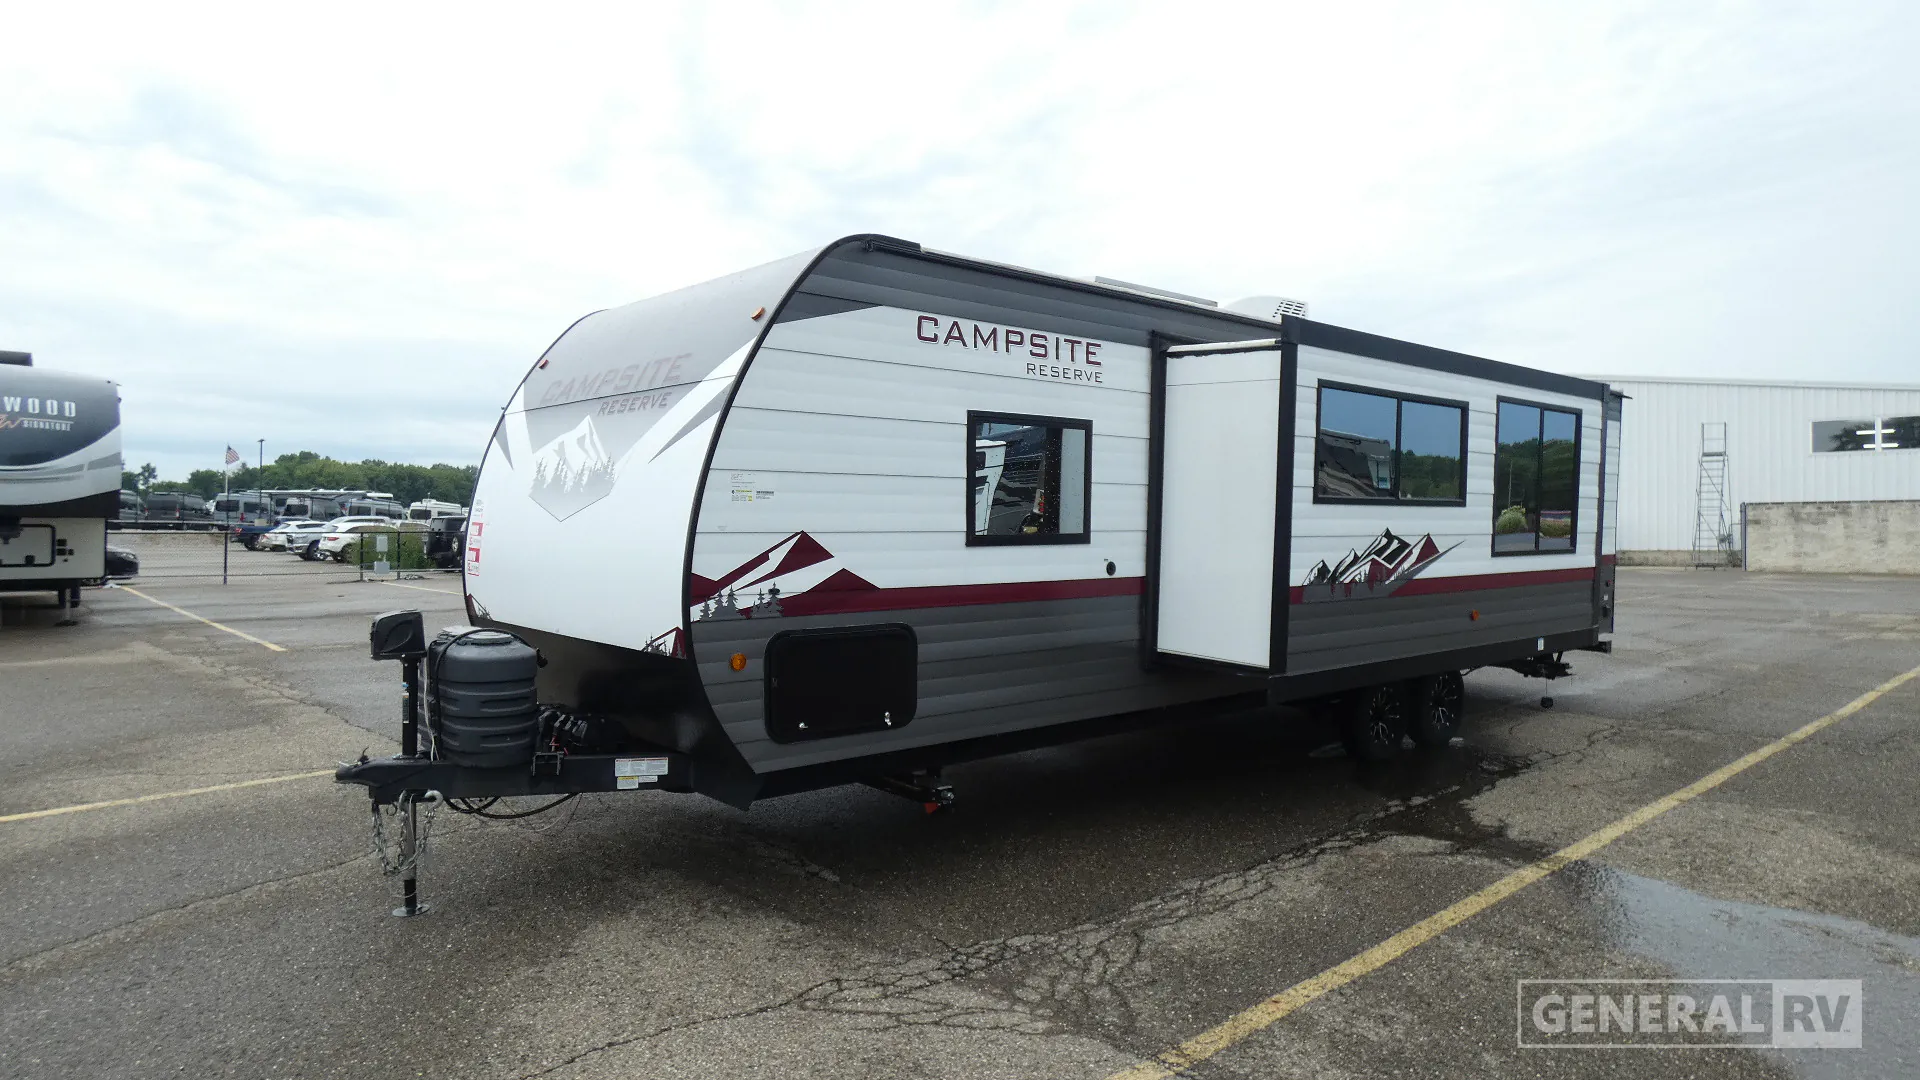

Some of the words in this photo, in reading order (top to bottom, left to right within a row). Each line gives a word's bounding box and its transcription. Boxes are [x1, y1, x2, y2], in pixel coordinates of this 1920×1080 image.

[917, 315, 1102, 366] CAMPSITE
[541, 353, 692, 402] CAMPSITE
[1026, 362, 1103, 384] RESERVE
[597, 392, 672, 416] RESERVE
[23, 420, 71, 431] SIGNATURE
